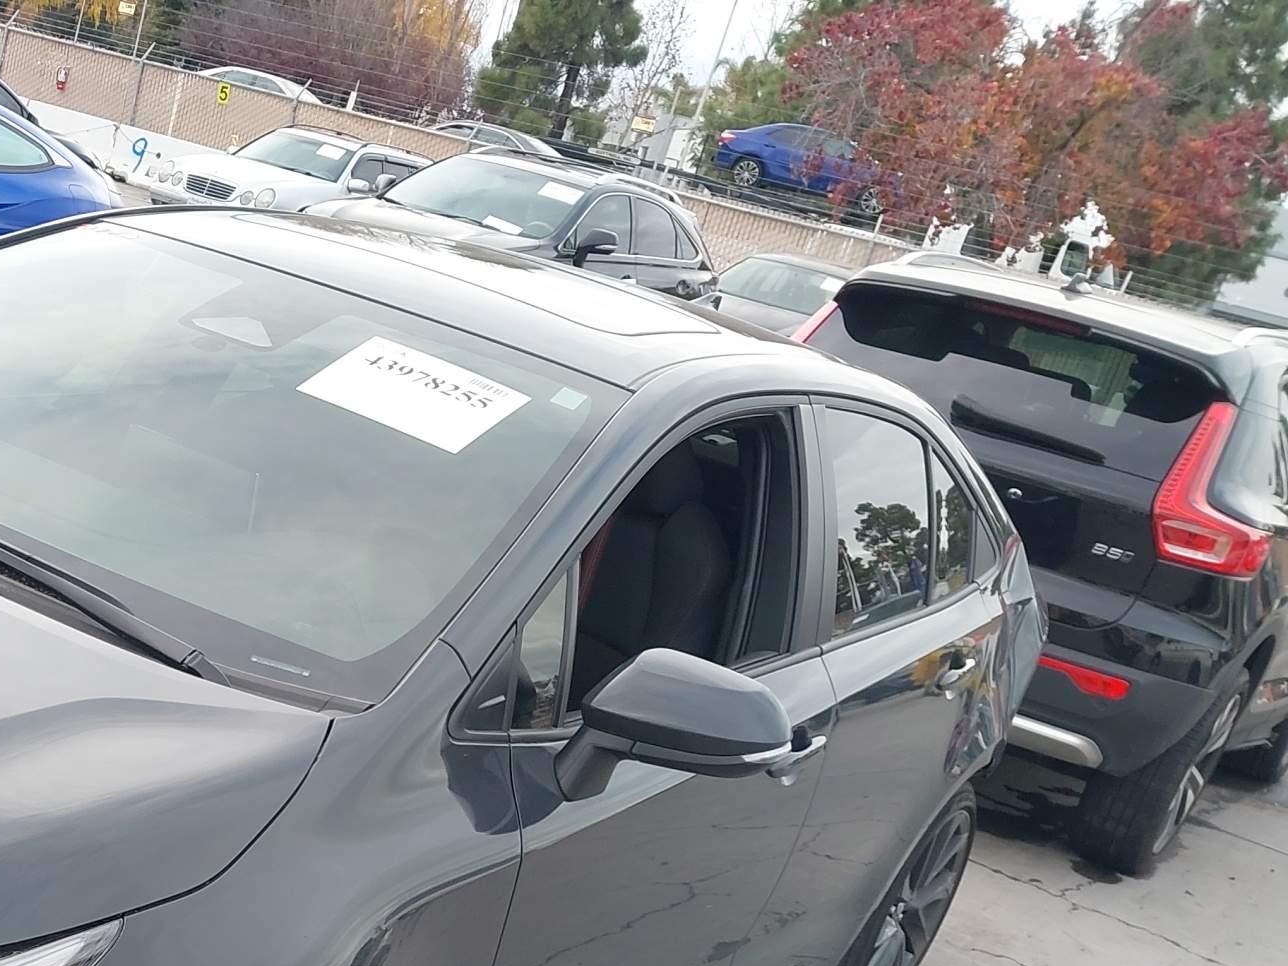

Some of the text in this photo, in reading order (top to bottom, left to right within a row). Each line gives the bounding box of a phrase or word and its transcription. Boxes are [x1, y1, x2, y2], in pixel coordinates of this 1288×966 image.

[219, 85, 229, 101] 5
[132, 137, 148, 173] 9
[364, 356, 493, 408] 43978255
